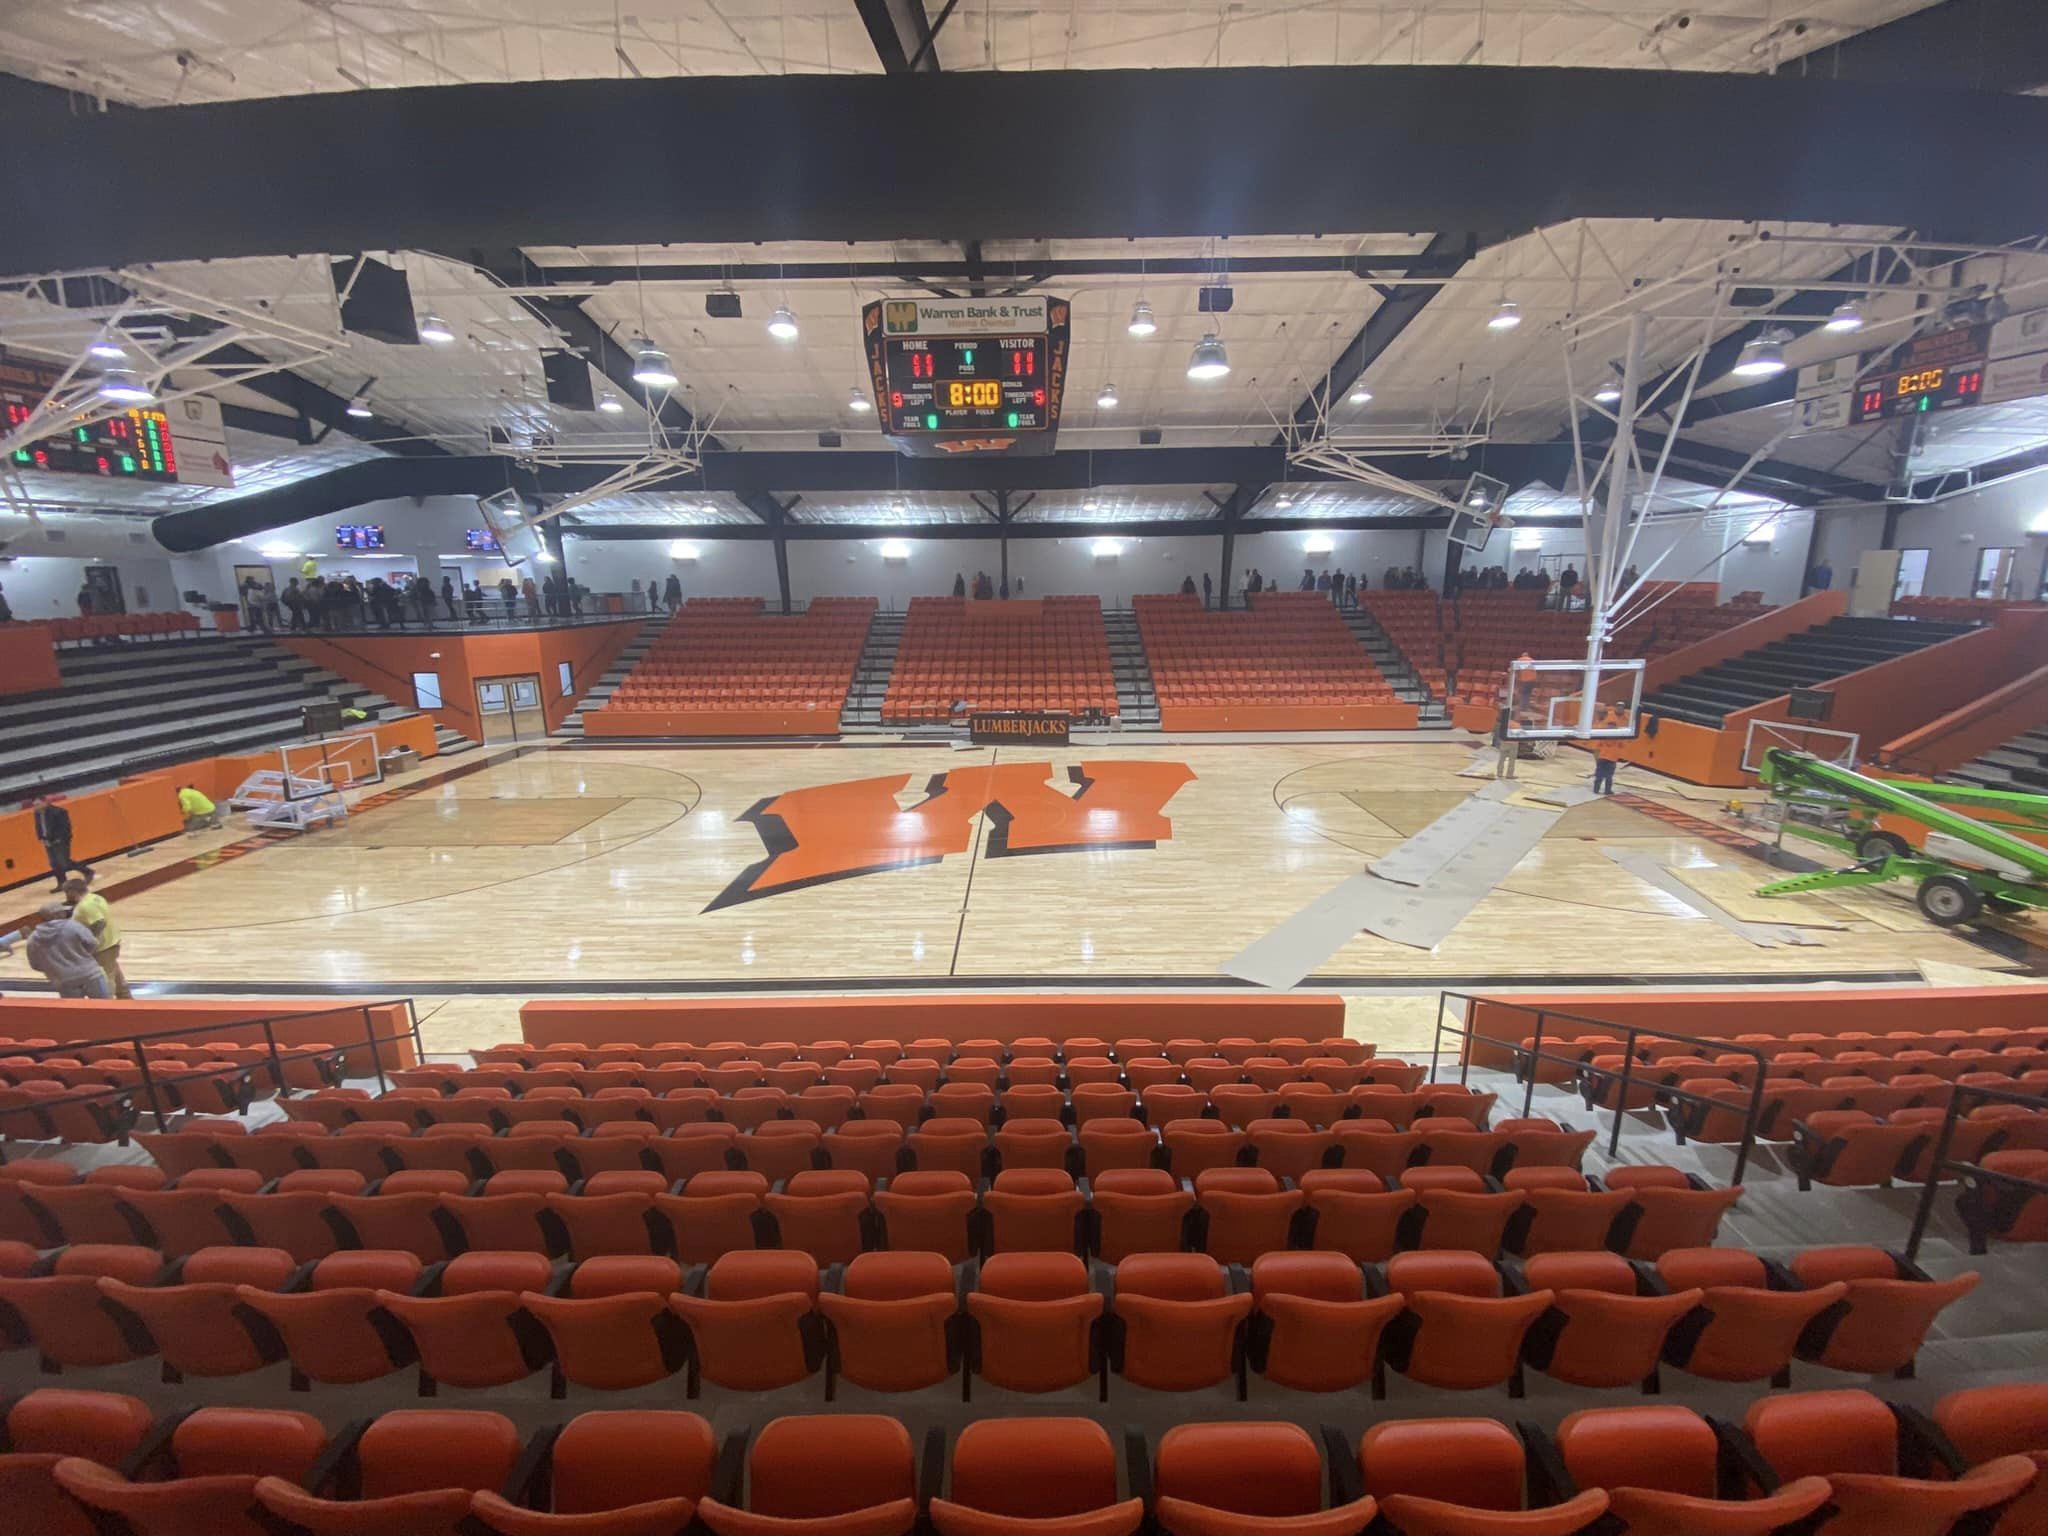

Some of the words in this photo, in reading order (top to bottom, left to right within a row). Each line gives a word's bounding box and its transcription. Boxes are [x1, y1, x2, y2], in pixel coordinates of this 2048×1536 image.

[919, 308, 964, 319] Warren
[967, 306, 997, 318] Bank
[999, 306, 1009, 317] &
[1012, 306, 1043, 317] Trust
[902, 341, 929, 350] HOME
[1000, 339, 1035, 349] VISITOR
[912, 353, 934, 377] 11
[1013, 351, 1034, 376] 11
[1957, 371, 1980, 394] 11
[949, 382, 999, 406] 8:00
[1863, 391, 1881, 411] 11
[973, 719, 1067, 736] LUMBERJACKS
